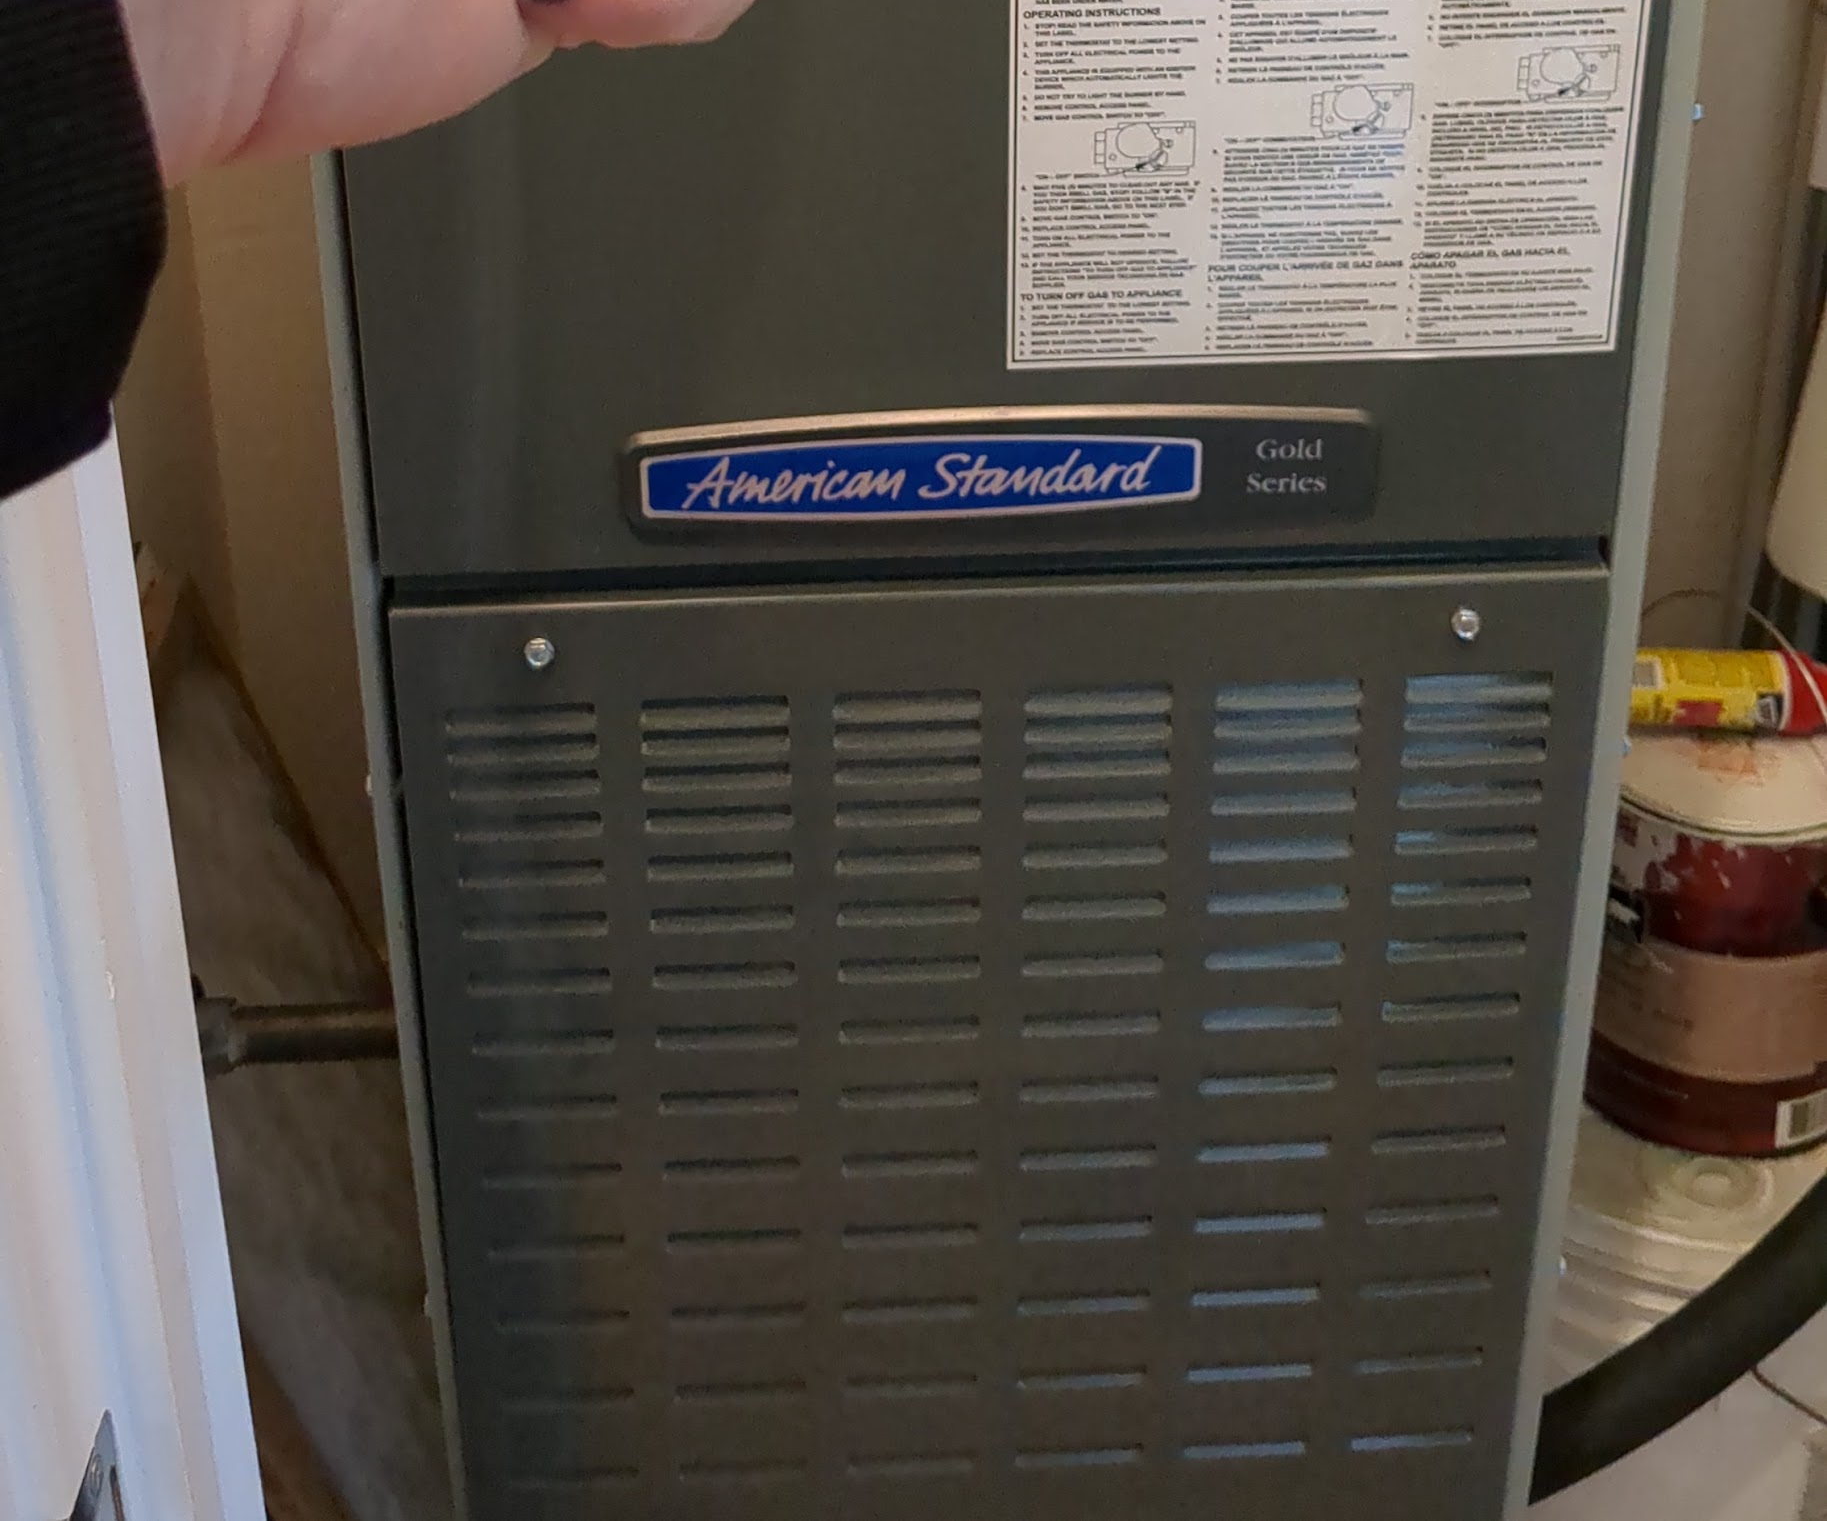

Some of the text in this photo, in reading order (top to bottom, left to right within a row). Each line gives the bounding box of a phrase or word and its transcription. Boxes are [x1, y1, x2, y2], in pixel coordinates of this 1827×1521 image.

[1256, 438, 1323, 460] Gold
[681, 445, 1162, 510] American Standard
[1246, 473, 1327, 494] Series
